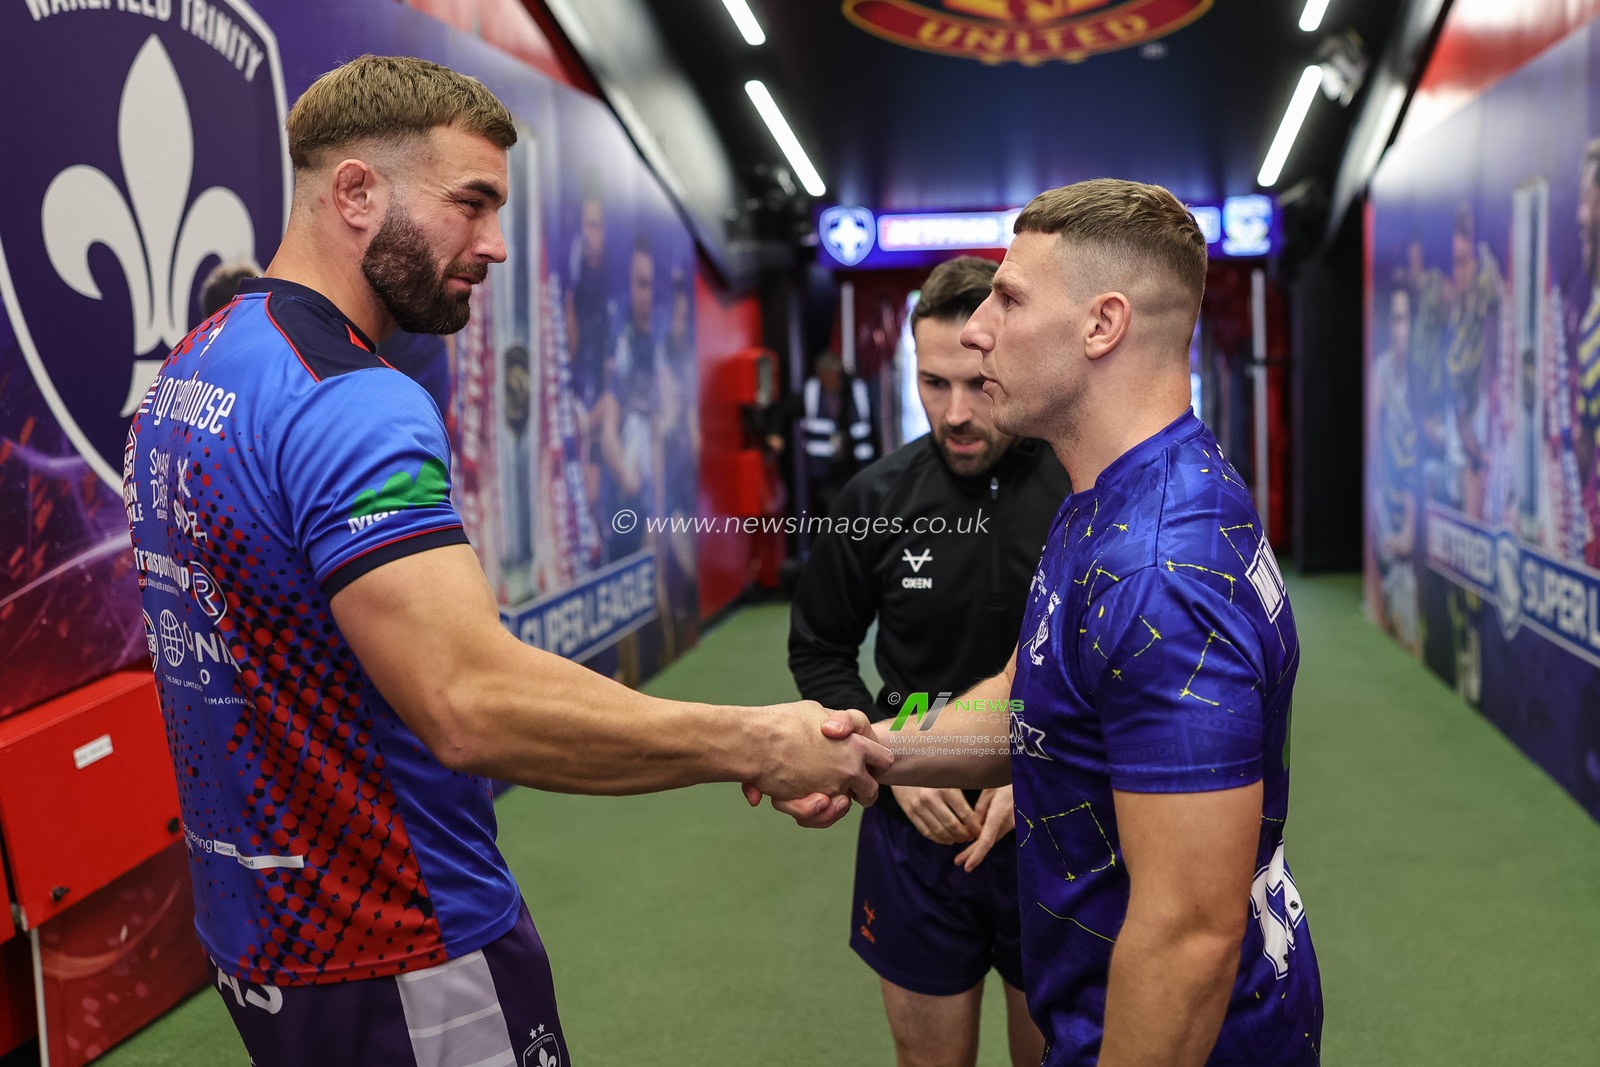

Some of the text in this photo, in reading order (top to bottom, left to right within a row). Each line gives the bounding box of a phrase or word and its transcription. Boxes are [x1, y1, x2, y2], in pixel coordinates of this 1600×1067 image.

[180, 0, 265, 82] TRINITY
[916, 13, 1149, 53] UNITED
[901, 578, 933, 590] OXEN
